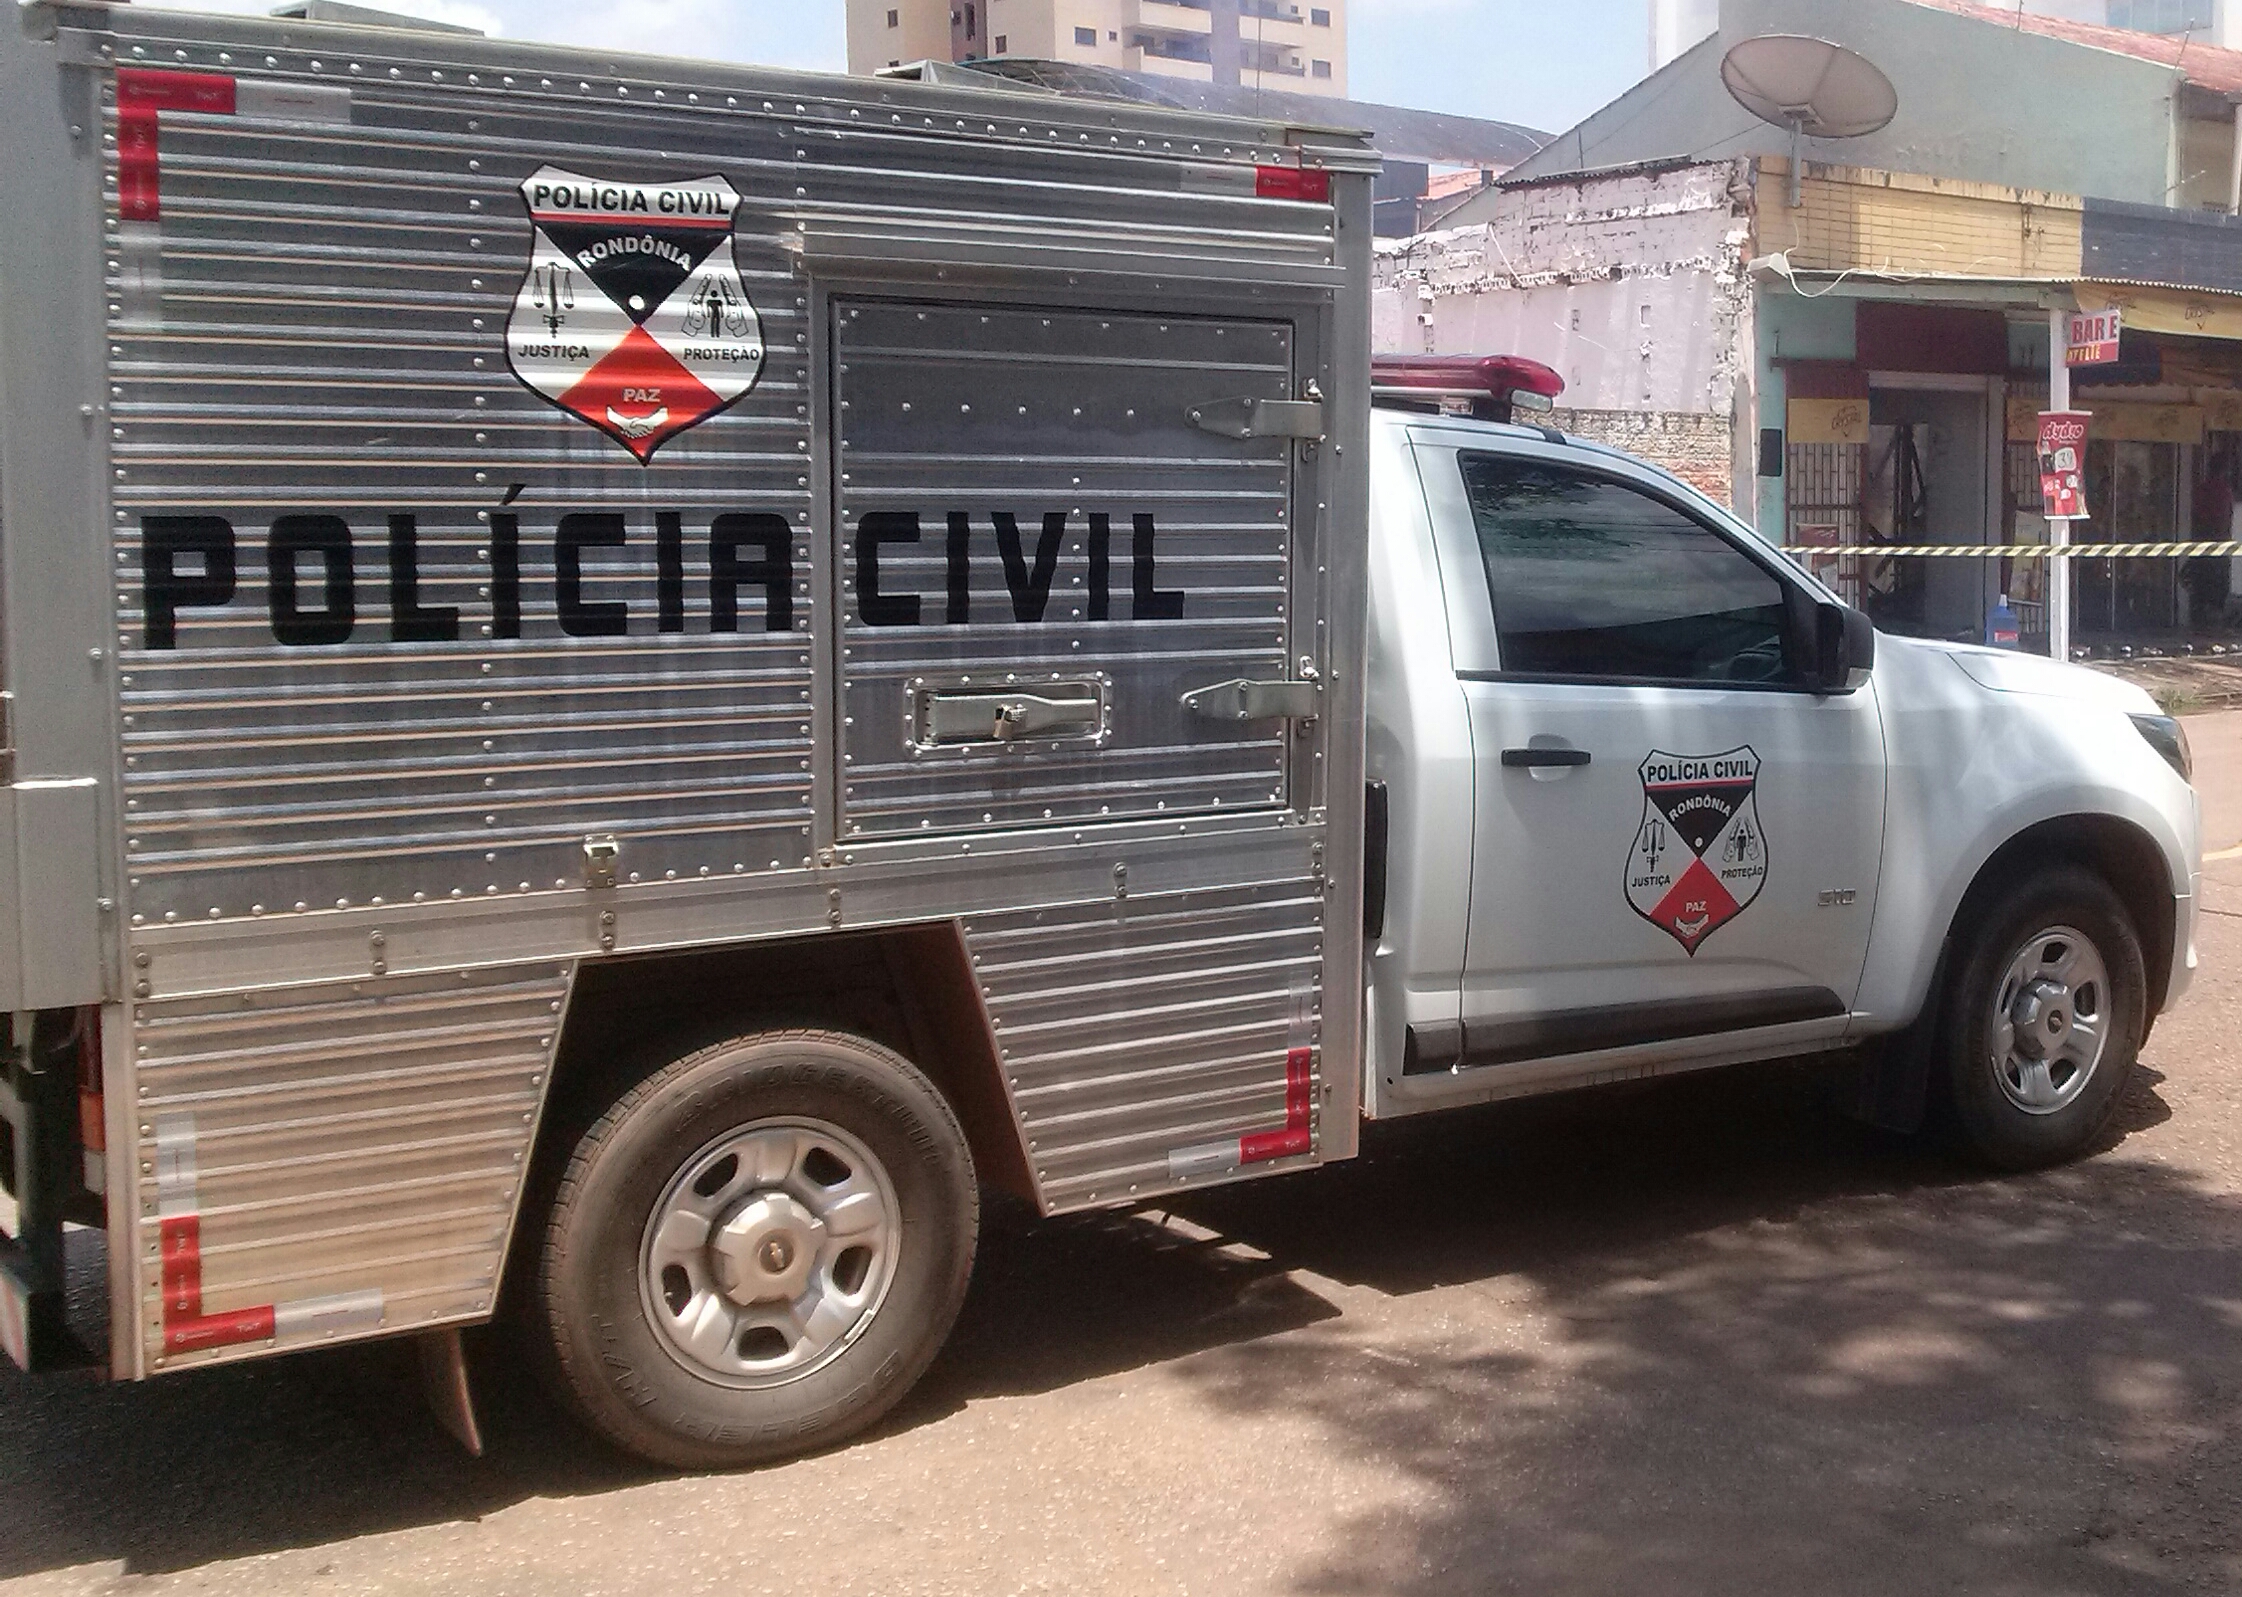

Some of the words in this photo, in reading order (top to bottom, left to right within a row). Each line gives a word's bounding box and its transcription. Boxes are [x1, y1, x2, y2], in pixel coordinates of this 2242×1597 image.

[533, 181, 649, 212] POLÍCIA
[658, 190, 731, 215] CIVIL
[576, 235, 692, 272] RONDÔNIA
[2072, 317, 2105, 344] BAR
[2109, 314, 2118, 339] E
[518, 345, 590, 361] JUSTIÇA
[683, 345, 760, 363] PROTEÇÃO
[622, 388, 661, 402] PAZ
[141, 483, 793, 650] POLÍCIA
[855, 511, 1185, 626] CIVIL
[1647, 760, 1709, 782] POLÍCIA
[1714, 760, 1753, 778] CIVIL
[1668, 794, 1732, 822] RONDÔNIA
[1631, 874, 1671, 888] JUSTIÇA
[1685, 901, 1707, 913] PAZ
